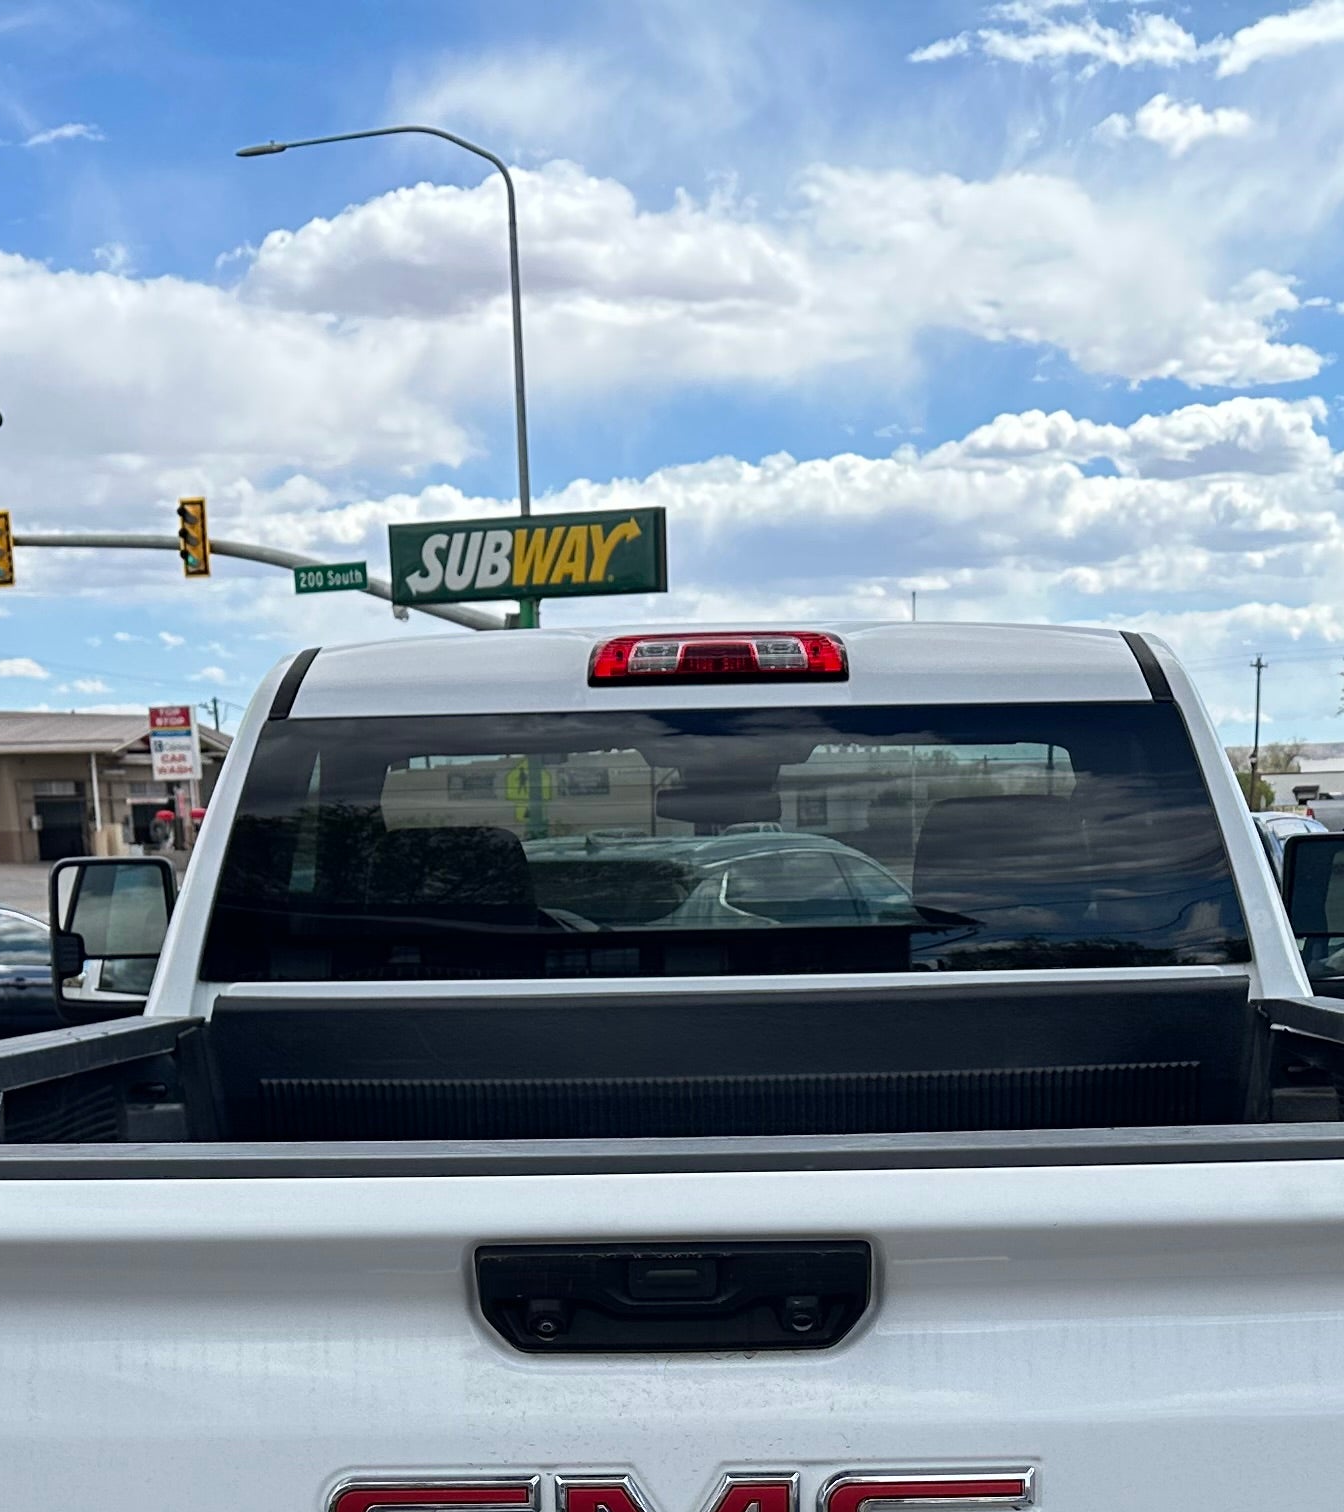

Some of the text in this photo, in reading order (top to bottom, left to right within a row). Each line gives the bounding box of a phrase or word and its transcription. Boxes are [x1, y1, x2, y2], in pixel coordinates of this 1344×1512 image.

[299, 569, 363, 588] 200 South
[406, 516, 642, 596] SUBWAY
